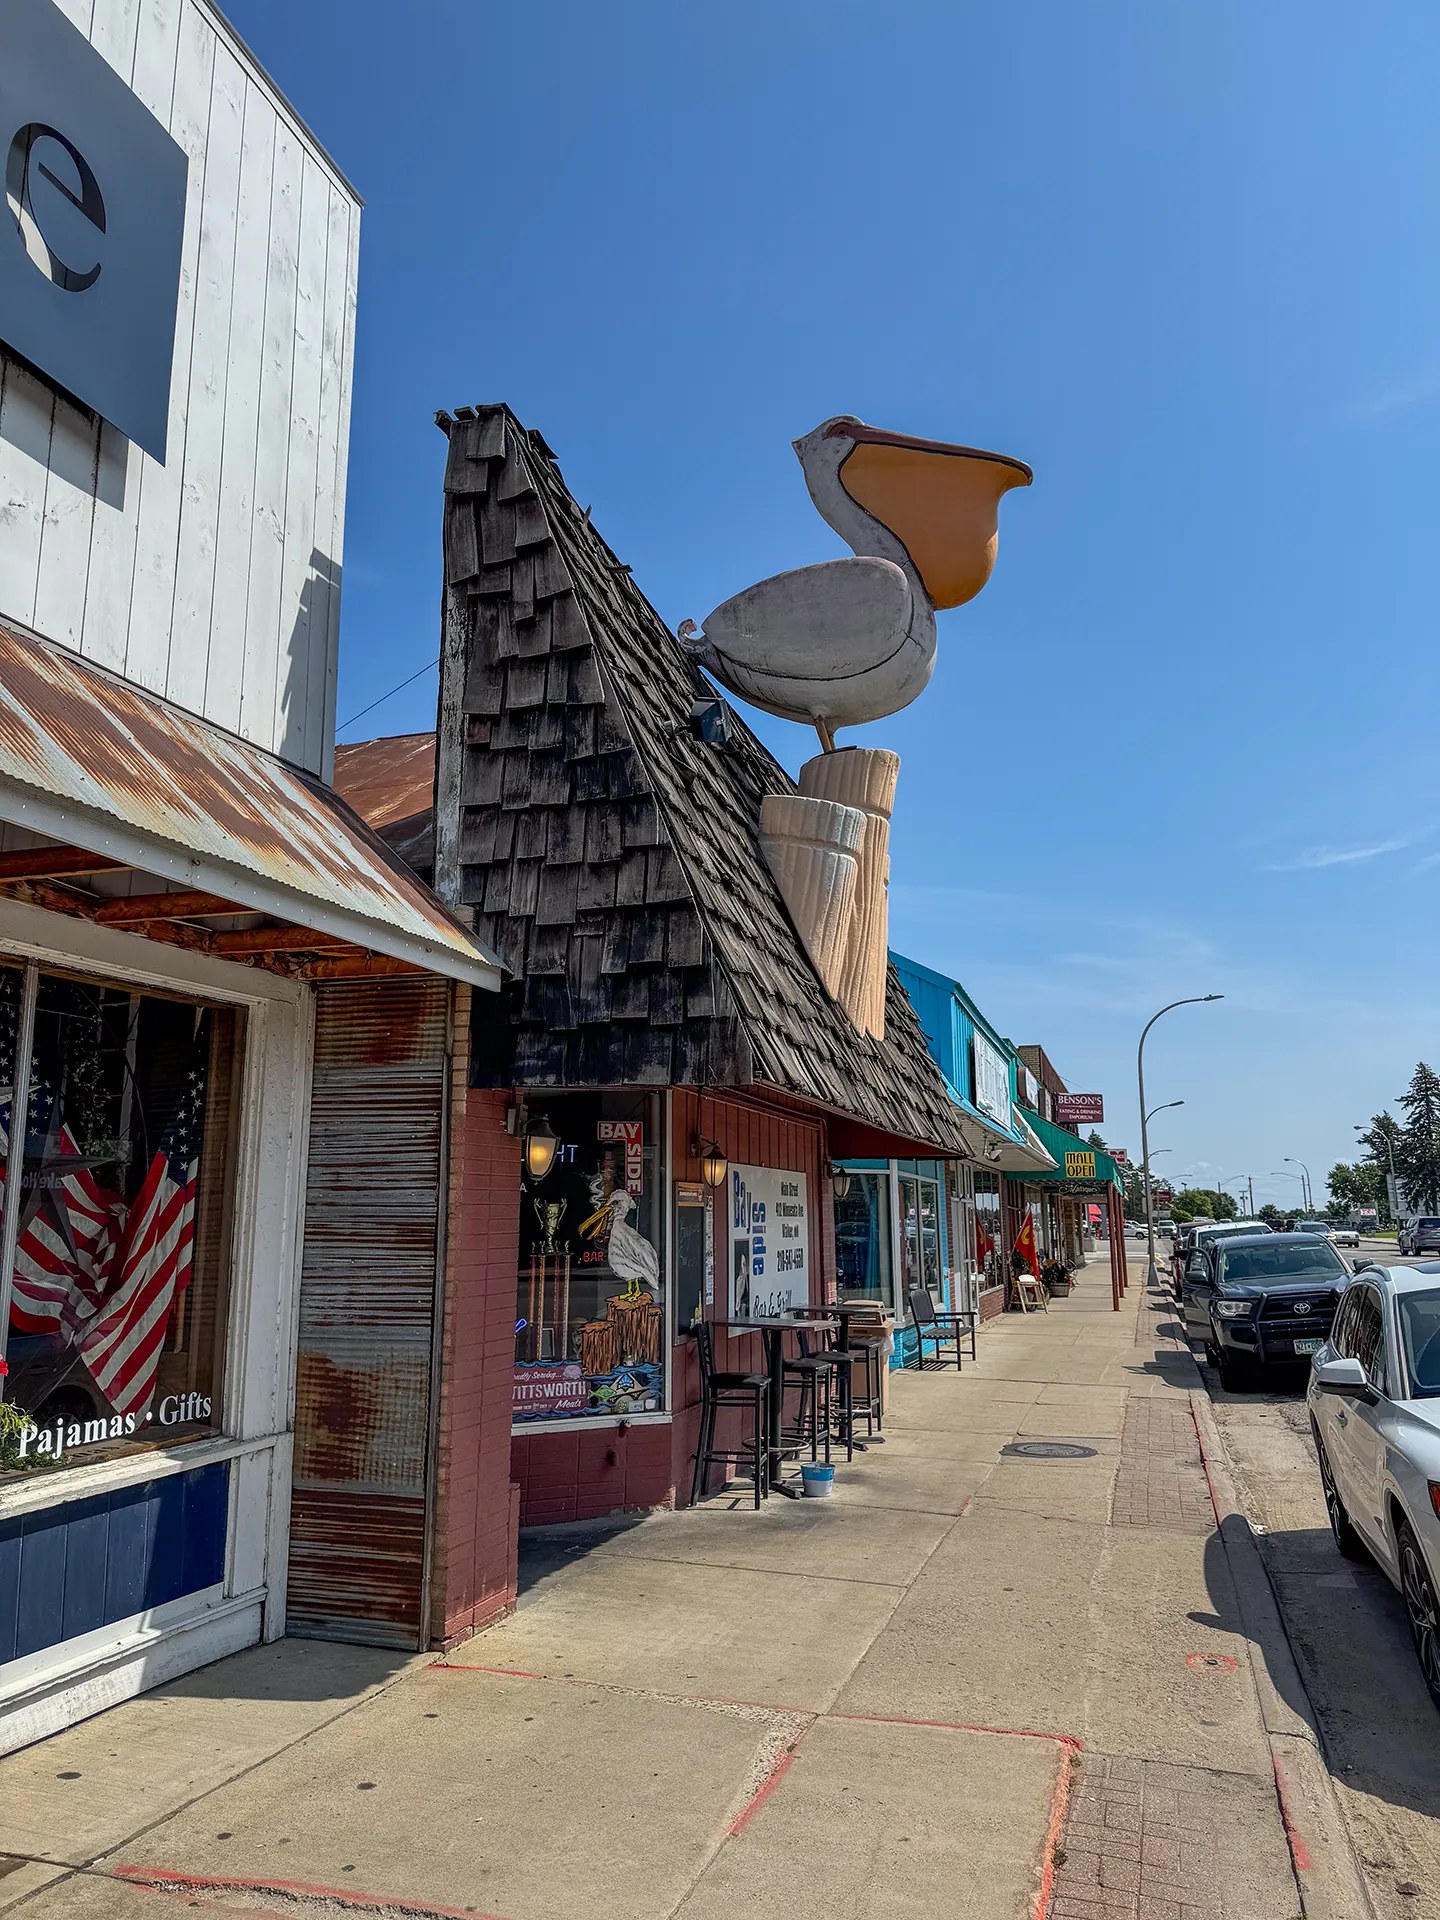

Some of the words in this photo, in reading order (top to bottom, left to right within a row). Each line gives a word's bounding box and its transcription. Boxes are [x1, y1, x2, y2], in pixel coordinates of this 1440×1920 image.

[1058, 1095, 1102, 1105] BENSON'S
[600, 1123, 640, 1139] BAY
[1066, 1153, 1094, 1164] MALL
[627, 1143, 642, 1193] SIDE
[1067, 1165, 1095, 1177] OPEN
[733, 1170, 751, 1234] Bay
[555, 1399, 581, 1409] Meats
[16, 1411, 136, 1460] Pajamas
[159, 1391, 212, 1426] Gifts
